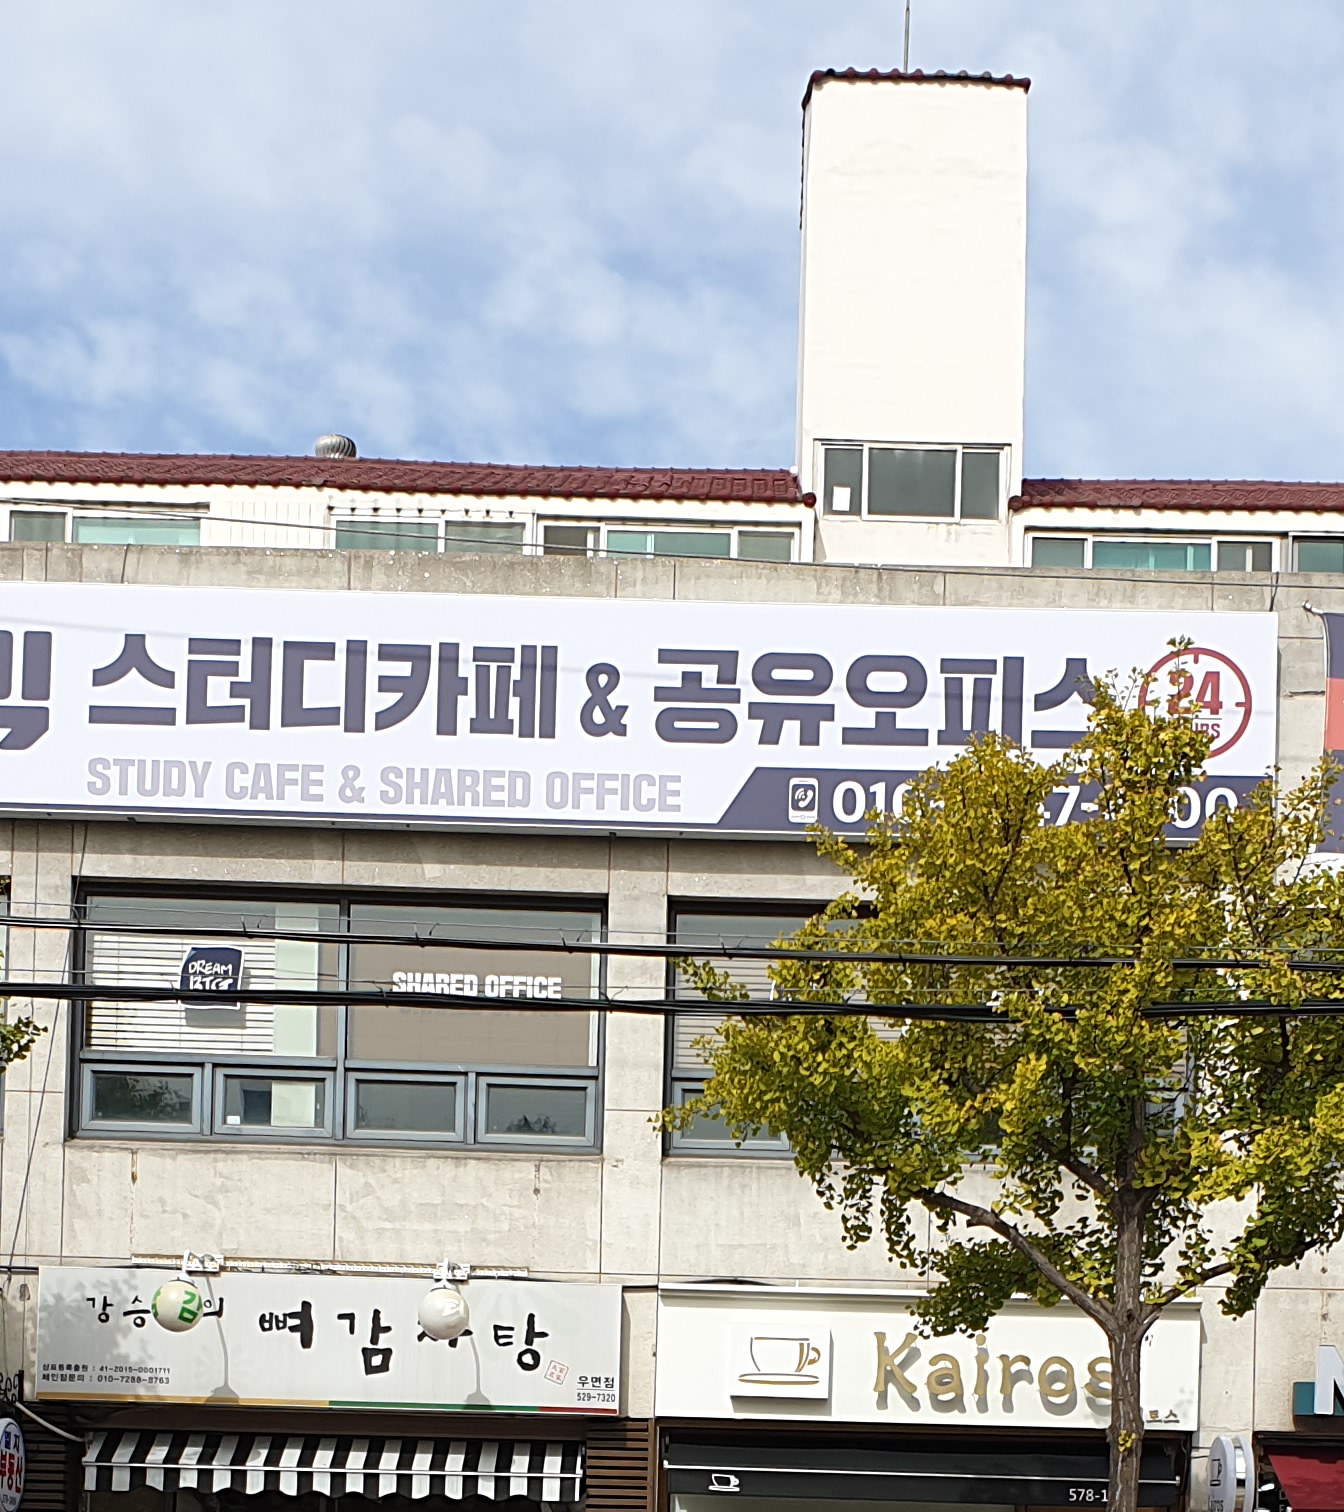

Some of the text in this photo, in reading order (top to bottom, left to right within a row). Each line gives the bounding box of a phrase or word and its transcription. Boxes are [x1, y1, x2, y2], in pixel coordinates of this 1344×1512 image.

[88, 633, 1102, 750] 스터디카페 & 공유오피스
[87, 757, 682, 814] STUDY CAFE & SHARED OFFICE
[188, 960, 233, 976] DREAM
[392, 970, 562, 1000] SHARED OFFICE
[577, 1375, 616, 1389] 우면점
[873, 1330, 1114, 1400] Kairos
[576, 1392, 616, 1404] 529-7320
[0, 1449, 23, 1494] 부동산
